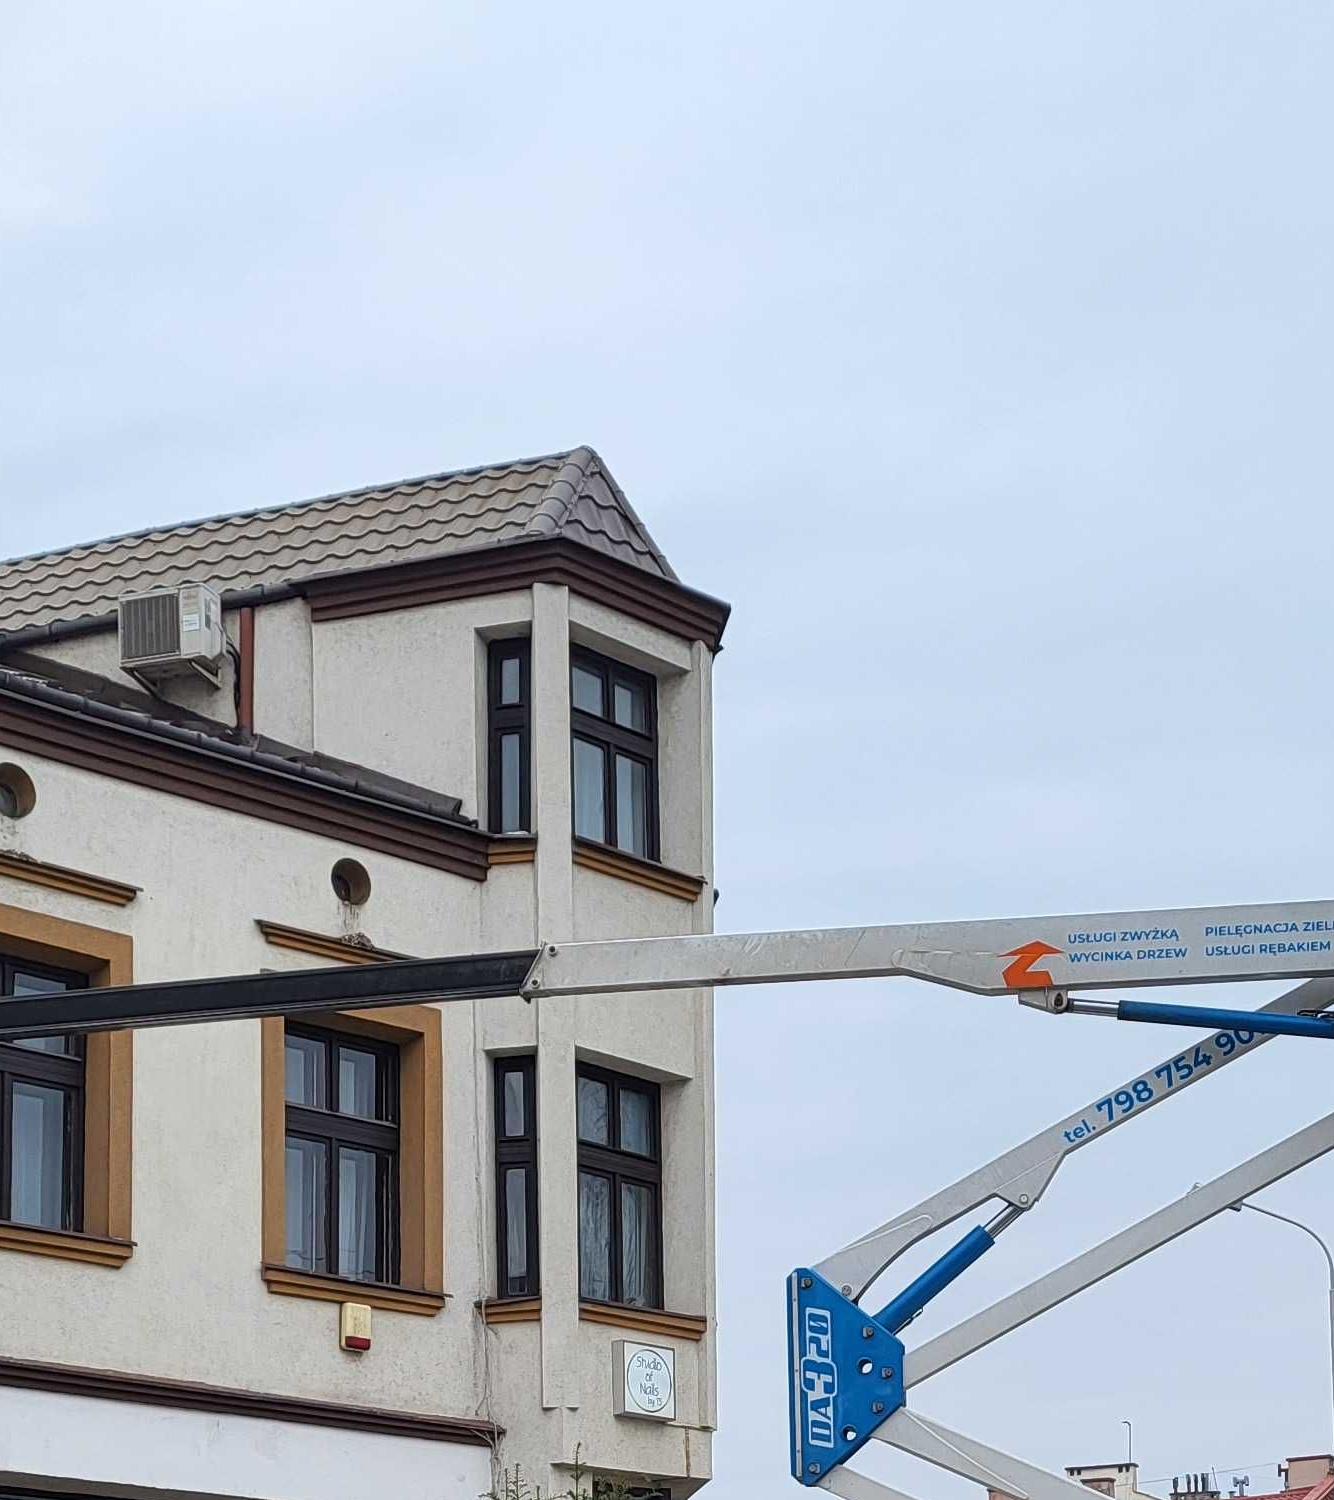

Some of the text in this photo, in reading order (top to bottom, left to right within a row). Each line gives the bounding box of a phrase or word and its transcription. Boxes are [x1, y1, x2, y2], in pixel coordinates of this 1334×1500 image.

[1068, 926, 1180, 944] USŁUGI ZWYŻKĄ
[1204, 922, 1299, 938] PIELĘGNACJA
[1069, 947, 1188, 963] WYCINKA DRZEW
[1205, 940, 1331, 957] USŁUGI RĘBAKIEM
[1063, 1028, 1269, 1143] tel. 798 754 90
[635, 1355, 663, 1371] Studio
[645, 1371, 654, 1382] of
[639, 1383, 660, 1397] Nails
